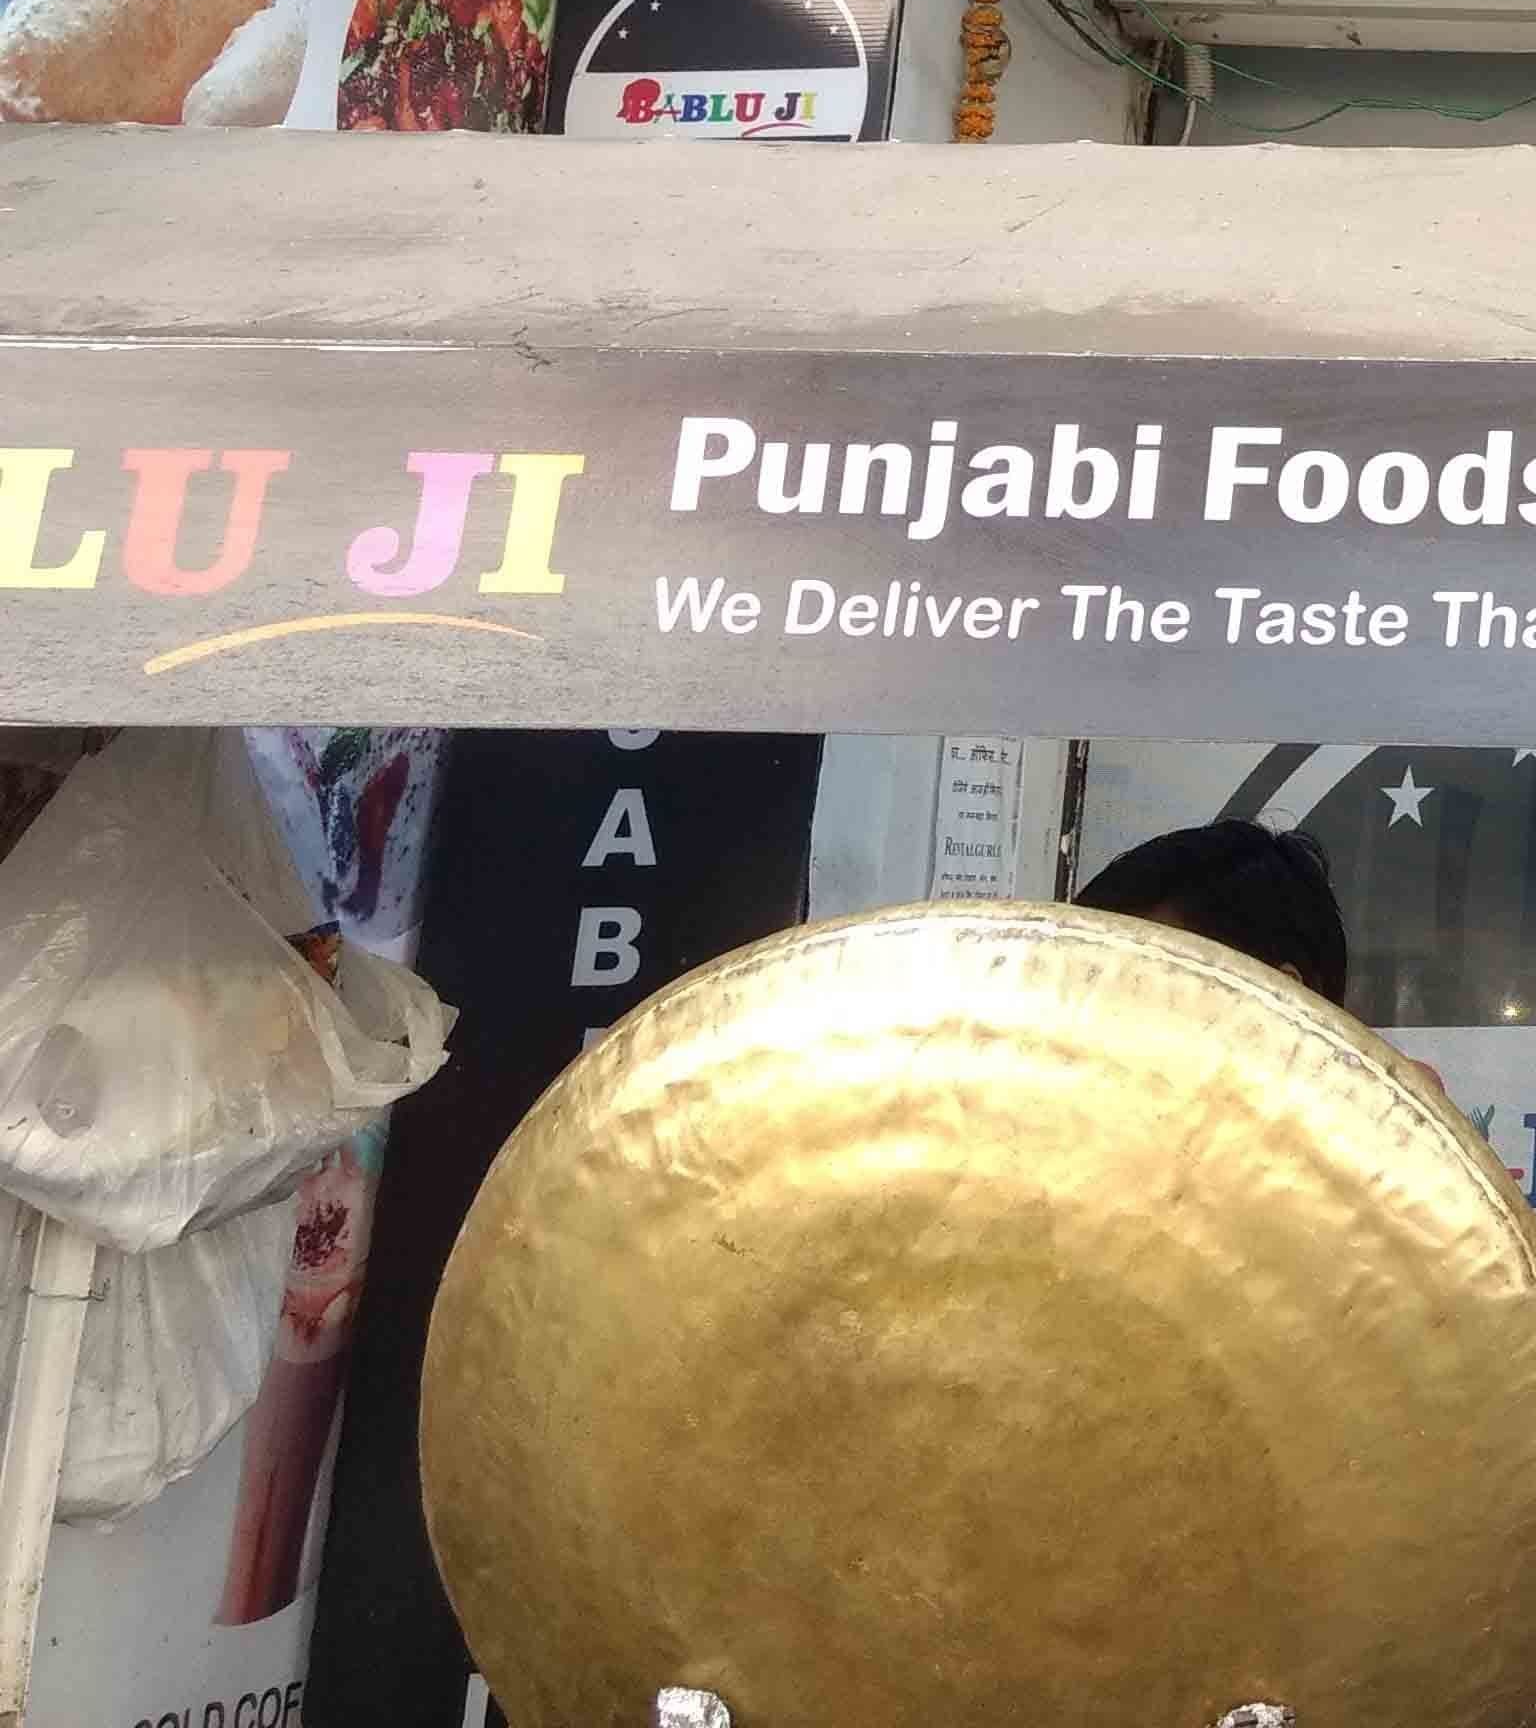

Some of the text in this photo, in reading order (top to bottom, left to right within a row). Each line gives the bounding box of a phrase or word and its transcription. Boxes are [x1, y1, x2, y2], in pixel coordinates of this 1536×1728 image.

[622, 90, 818, 124] BABLU JI
[344, 450, 586, 599] JI
[668, 414, 1165, 540] Punjabi
[653, 576, 762, 636] We
[782, 577, 1040, 641] Deliver
[1058, 584, 1191, 644] The
[1213, 585, 1410, 649] Taste
